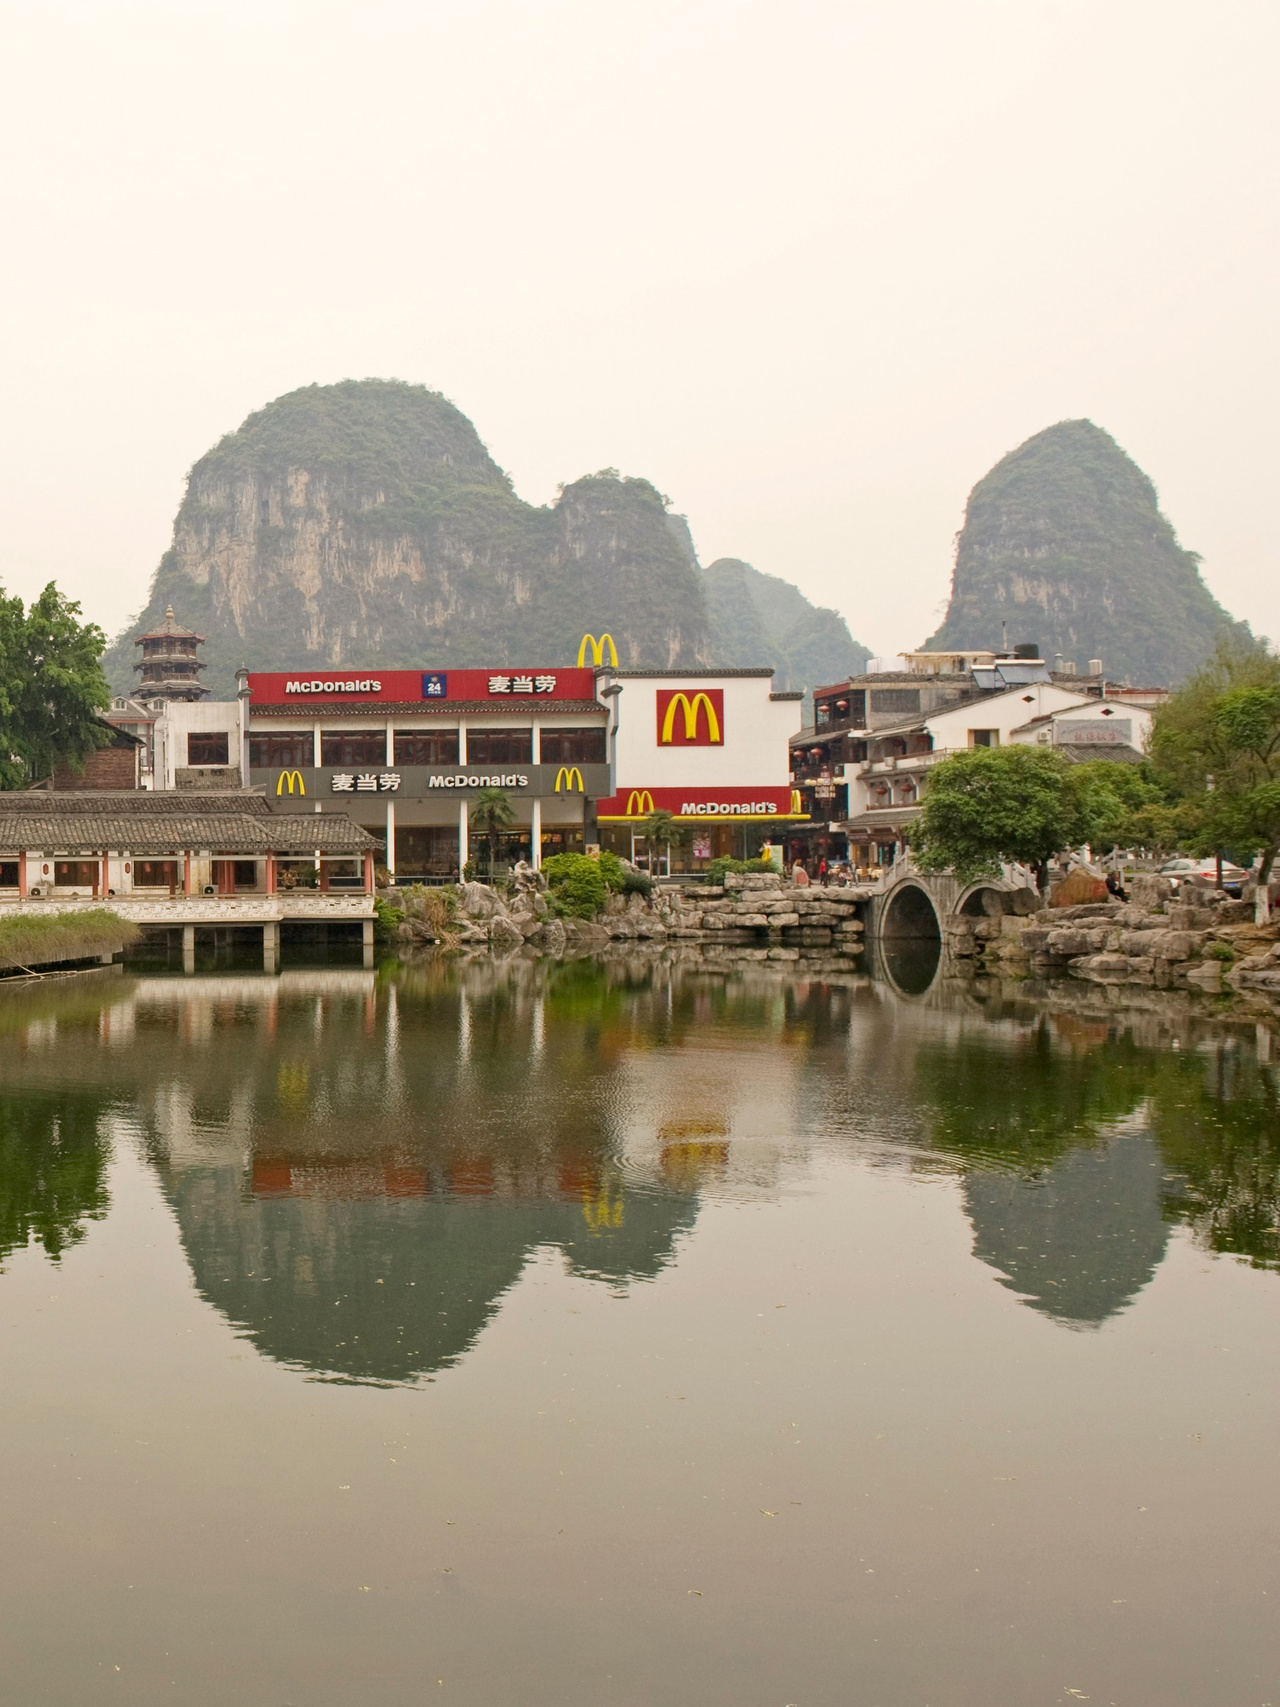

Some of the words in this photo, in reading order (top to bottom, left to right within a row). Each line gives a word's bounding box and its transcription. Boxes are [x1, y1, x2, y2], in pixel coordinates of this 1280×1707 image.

[577, 633, 618, 668] M
[285, 680, 382, 693] McDonald's
[427, 682, 441, 692] 24
[488, 675, 556, 693] 麦当劳
[662, 692, 720, 743] M
[276, 770, 305, 796] M
[331, 773, 401, 792] 麦当劳
[428, 774, 529, 788] McDonald's
[554, 766, 584, 793] M
[626, 790, 655, 815] M
[680, 802, 778, 815] McDonald's
